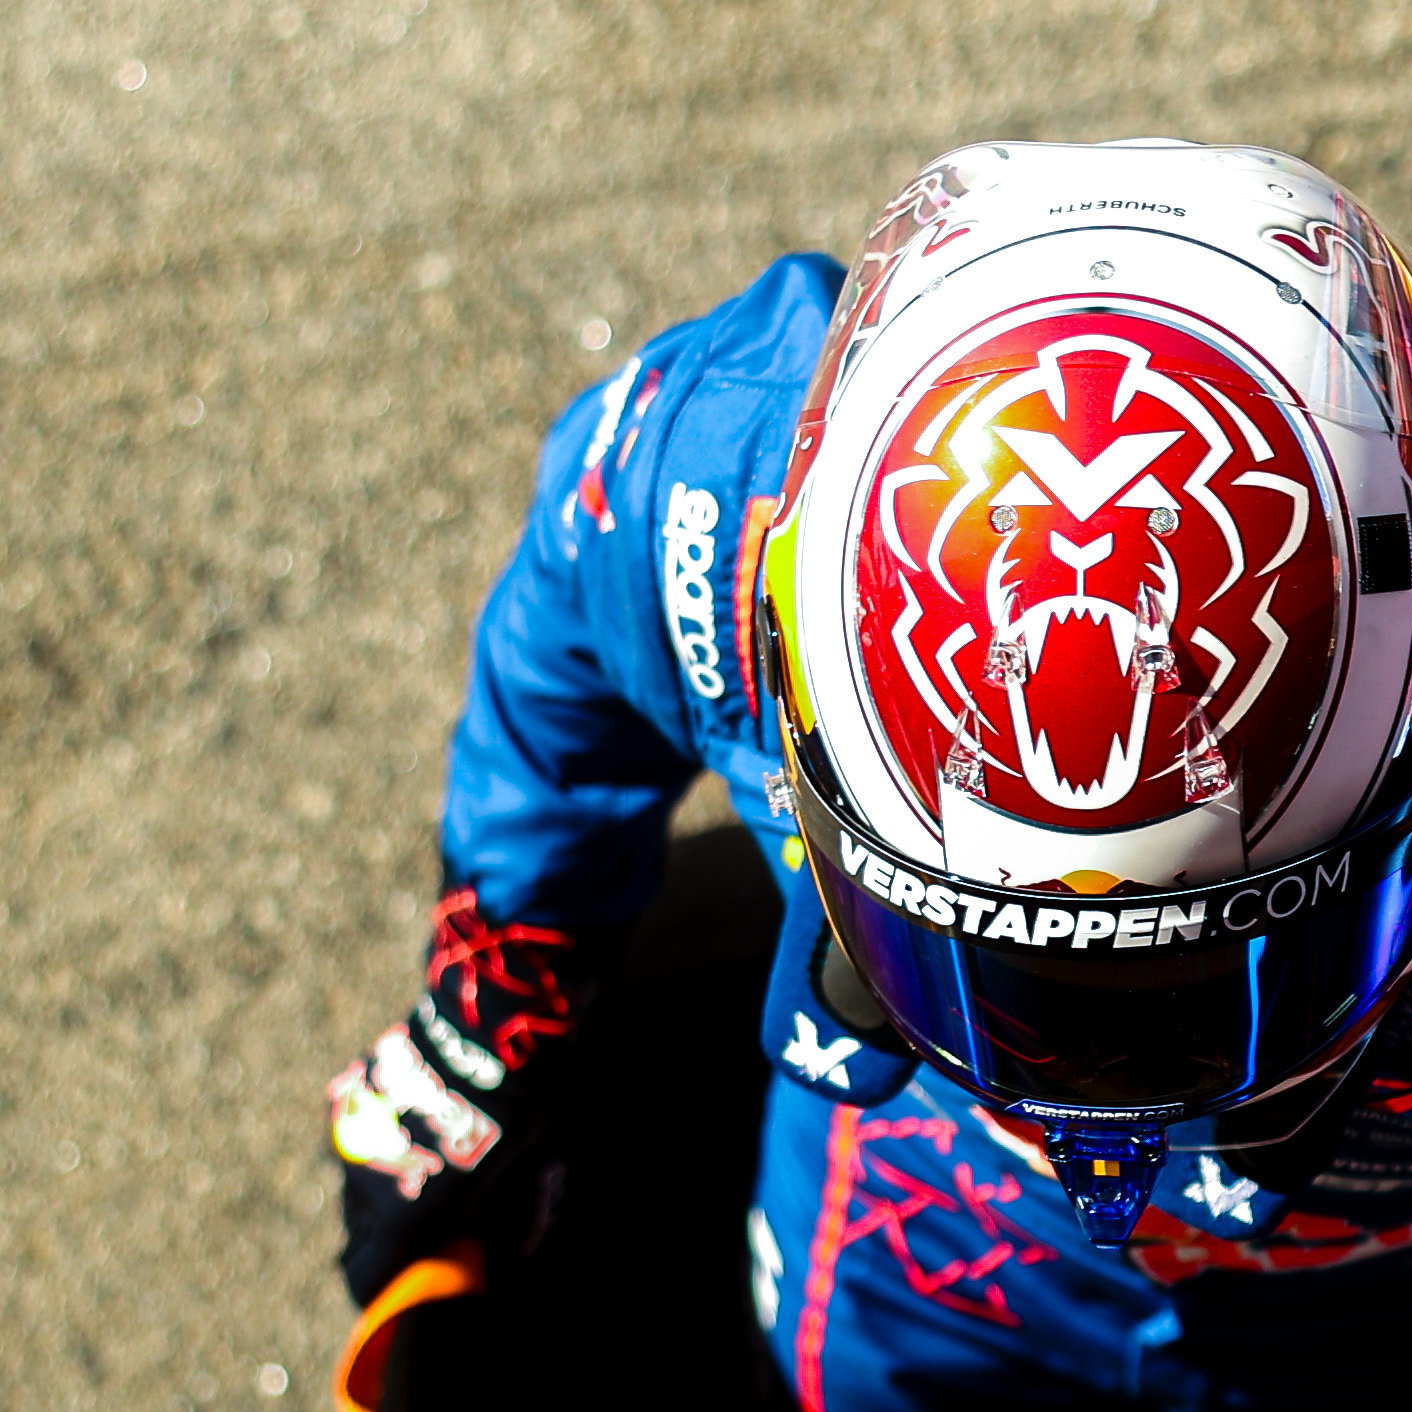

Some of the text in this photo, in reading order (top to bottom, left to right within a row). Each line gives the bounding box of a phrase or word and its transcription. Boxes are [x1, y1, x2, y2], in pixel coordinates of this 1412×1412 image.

[1049, 200, 1187, 217] SCHUBERTH
[663, 485, 726, 700] sparco
[838, 830, 1352, 949] VERSTAPPEN.COM
